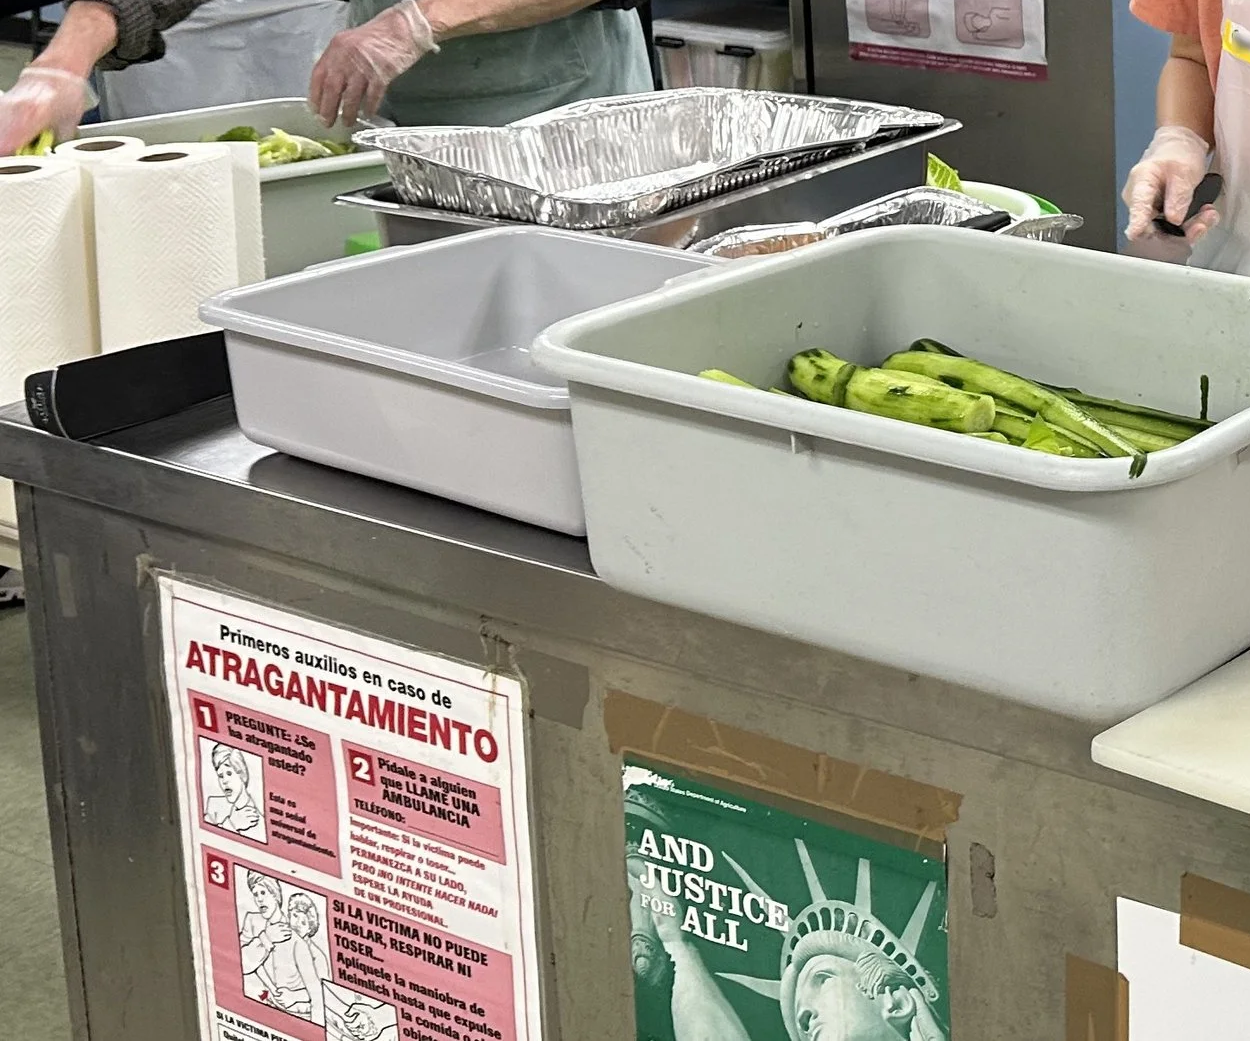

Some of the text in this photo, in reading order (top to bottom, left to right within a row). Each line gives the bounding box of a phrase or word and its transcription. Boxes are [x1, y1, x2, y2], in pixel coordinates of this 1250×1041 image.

[220, 624, 452, 709] Primeros auxilios en caso de
[185, 639, 499, 764] ATRAGANTAMIENTO
[200, 706, 213, 729] 1
[225, 710, 316, 751] PREGUNTE: ¿Se
[228, 726, 313, 764] ha atragantado
[268, 756, 307, 777] usted?
[352, 757, 371, 782] 2
[377, 757, 477, 800] Pídale a alguien
[354, 798, 407, 824] TELÉFONO:
[380, 775, 481, 817] que LLAME UNA
[382, 789, 472, 829] AMBULANCIA
[349, 845, 468, 895] PERMANEZCA A SU LADO,
[381, 843, 416, 861] respirar
[417, 856, 424, 864] o
[412, 838, 421, 849] la
[458, 855, 486, 871] puede
[638, 828, 715, 873] AND
[209, 860, 225, 885] 3
[352, 859, 376, 876] PERO
[396, 875, 433, 896] INTENTE
[435, 888, 466, 908] HACER
[352, 873, 433, 910] ESPERE LA AYUDA
[354, 887, 366, 898] DE
[368, 892, 381, 904] UN
[639, 860, 790, 933] JUSTICE
[333, 898, 489, 967] SI LA VICTIMA NO PUEDE
[640, 893, 748, 952] FOR ALL
[333, 917, 472, 979] HABLAR, RESPIRAR NI
[334, 934, 385, 963] TOSER...
[336, 951, 486, 1017] Aplíquele la maniobra de
[338, 968, 502, 1041] Heimlich hasta que expulse
[400, 1007, 413, 1022] la
[415, 1016, 460, 1041] comida
[225, 1014, 235, 1026] LA
[236, 1019, 270, 1039] VICTIMA
